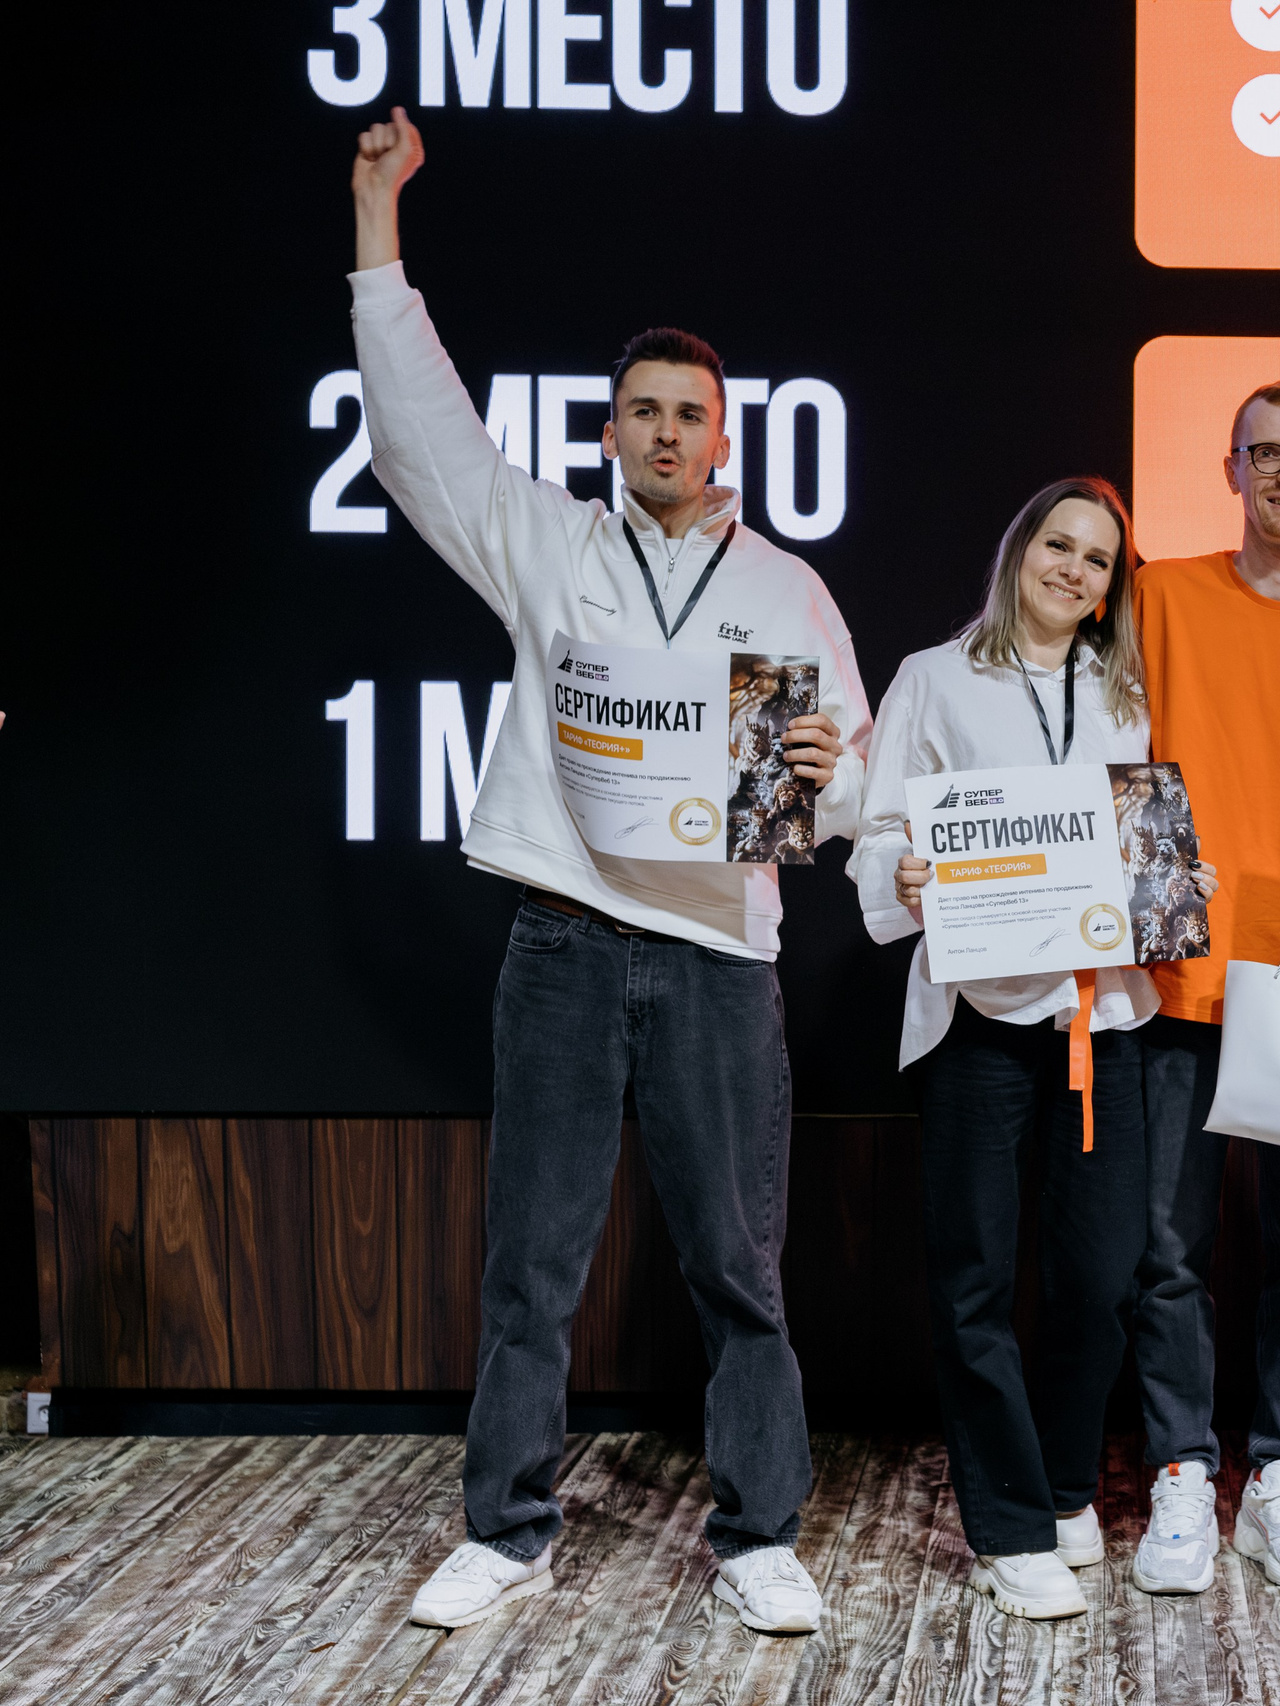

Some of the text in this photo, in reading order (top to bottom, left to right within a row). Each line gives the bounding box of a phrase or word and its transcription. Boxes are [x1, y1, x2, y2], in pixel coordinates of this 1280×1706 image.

[307, 0, 848, 116] 3 МЕСТО
[309, 369, 387, 533] 2
[555, 682, 706, 732] СЕРТИФИКАТ
[325, 679, 376, 841] 1
[964, 788, 1003, 798] СУПЕР
[965, 798, 988, 807] ВЕБ
[931, 811, 1096, 854] СЕРТИФИКАТ
[950, 861, 1031, 878] ТАРИФ «ТЕОРИЯ»
